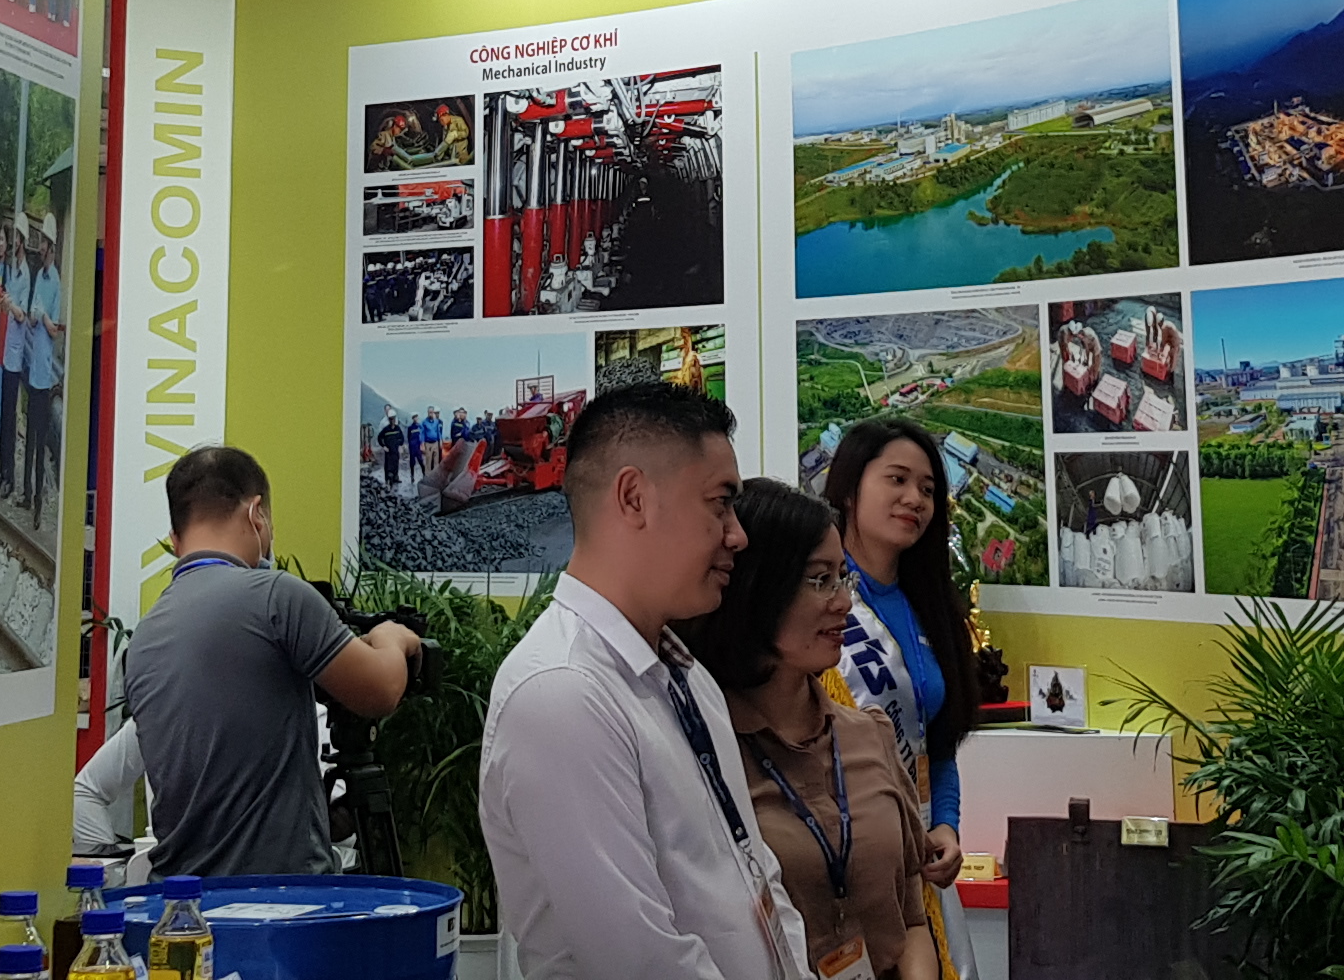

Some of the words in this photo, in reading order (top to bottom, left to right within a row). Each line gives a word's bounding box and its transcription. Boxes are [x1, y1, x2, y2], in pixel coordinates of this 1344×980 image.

[470, 45, 510, 64] CÔNG
[515, 36, 567, 58] NGHIỆP
[571, 34, 591, 52] CƠ
[594, 28, 618, 49] KHÍ
[482, 60, 552, 81] Mechanical
[554, 56, 606, 73] Industry
[143, 48, 205, 483] VINACOMIN
